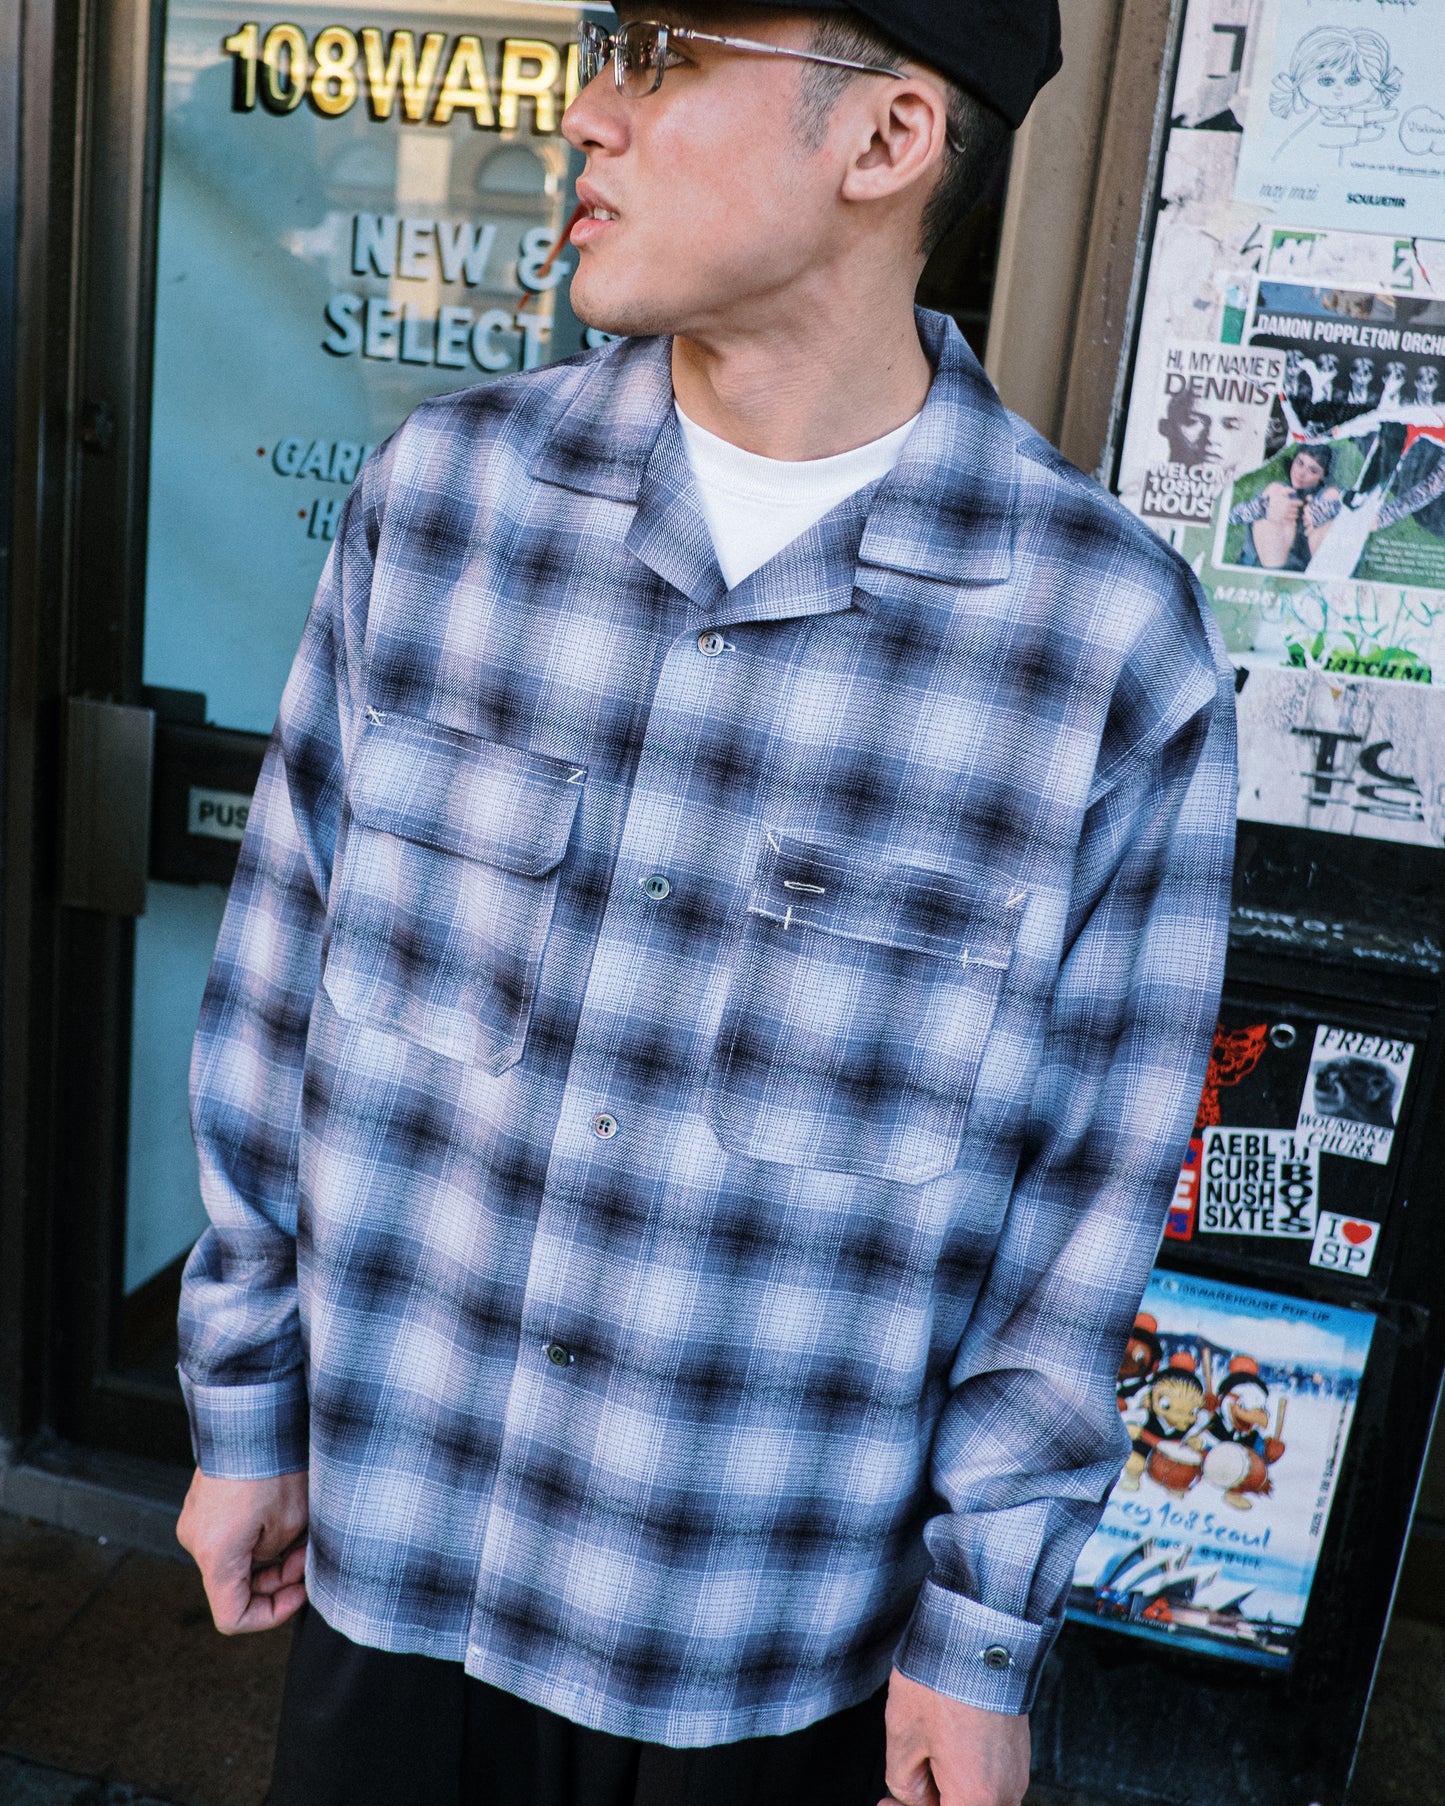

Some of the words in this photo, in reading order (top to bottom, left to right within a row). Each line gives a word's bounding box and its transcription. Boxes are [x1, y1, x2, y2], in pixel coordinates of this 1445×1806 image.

[352, 213, 496, 287] NEW
[517, 226, 571, 293] &
[322, 294, 553, 373] SELECT
[1257, 313, 1311, 341] DAMON
[1313, 320, 1400, 351] POPPLETON
[1190, 351, 1214, 373] MY
[1217, 354, 1264, 376] NAME
[1267, 359, 1281, 378] IS
[1164, 373, 1277, 406] DENNIS
[1207, 1133, 1276, 1157] AEBL
[1207, 1157, 1275, 1182] CURE
[1206, 1181, 1275, 1206] NUSH
[1204, 1205, 1275, 1231] SIXTE
[1325, 1216, 1340, 1240] I
[1319, 1242, 1366, 1272] SP
[1203, 1513, 1272, 1550] Seoul
